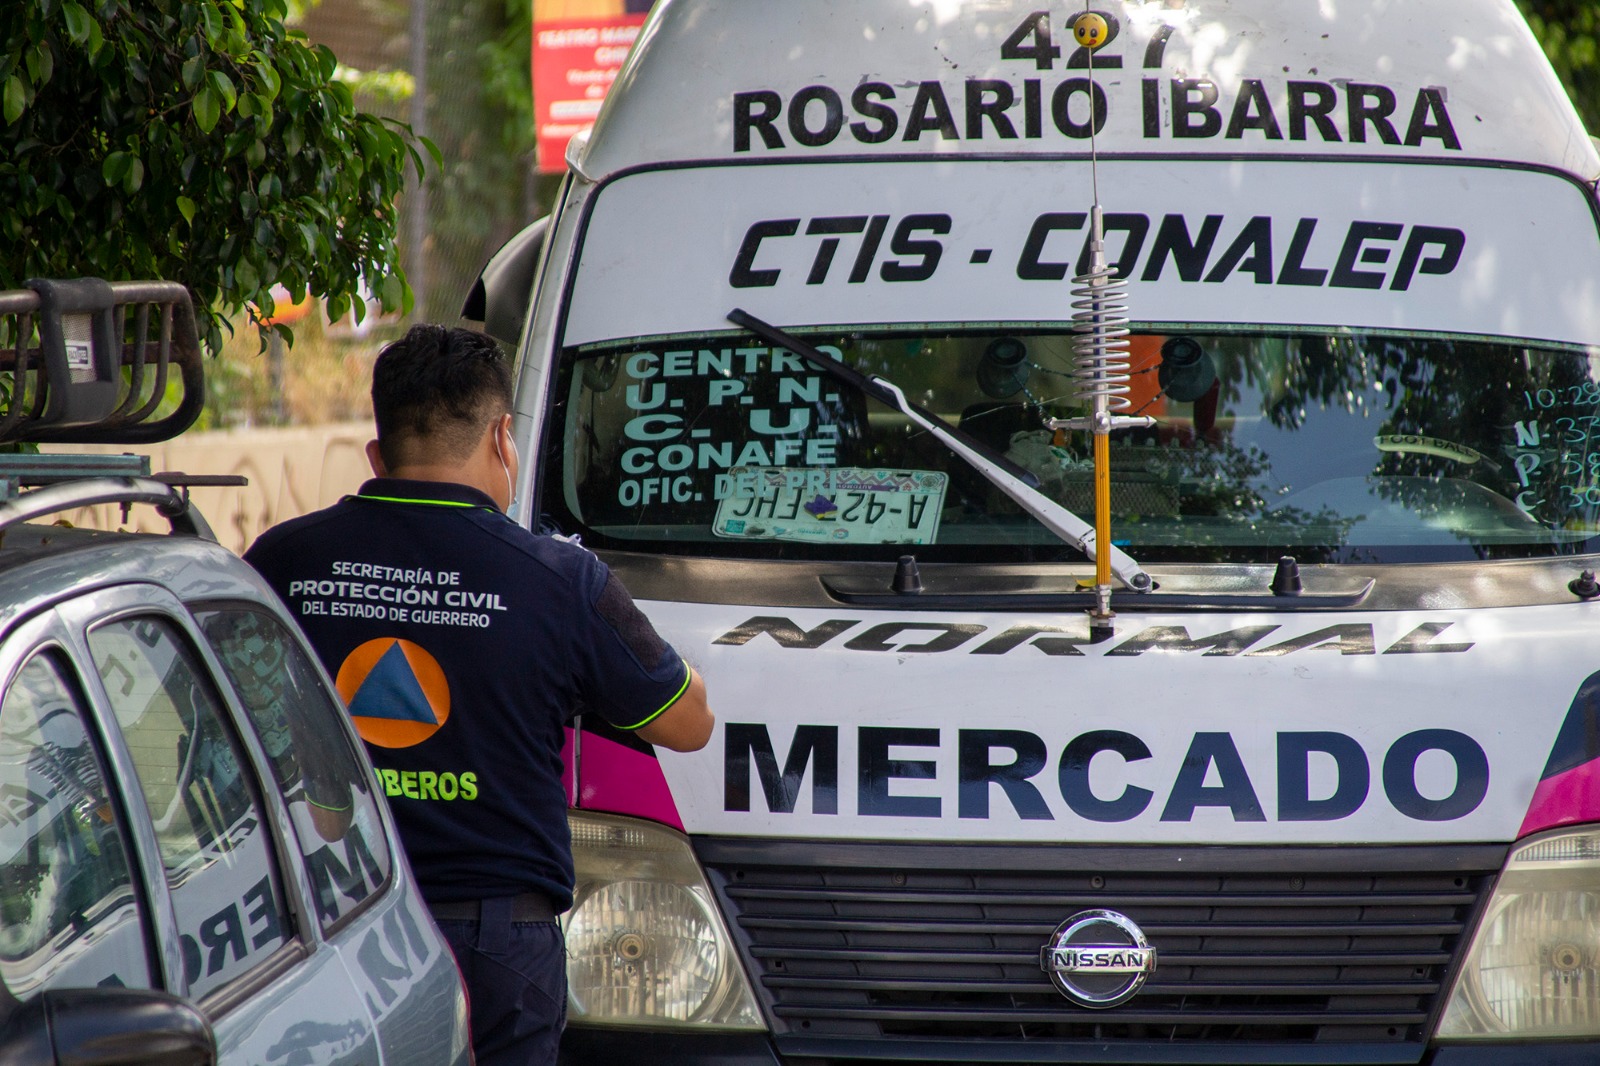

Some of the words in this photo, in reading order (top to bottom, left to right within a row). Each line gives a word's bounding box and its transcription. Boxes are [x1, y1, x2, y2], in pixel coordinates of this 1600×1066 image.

[600, 25, 645, 44] MAR
[731, 77, 1107, 152] ROSARIO
[1141, 78, 1462, 151] IBARRA
[729, 213, 952, 288] CTIS
[969, 248, 993, 264] -
[1016, 212, 1466, 291] CONALEP
[625, 345, 843, 379] CENTRO
[620, 438, 837, 475] CONAFE
[618, 475, 702, 507] OFIC.
[786, 469, 838, 498] PRI
[331, 561, 433, 585] SECRETARÍA
[437, 571, 460, 585] DE
[289, 580, 438, 606] PROTECCIÓN
[444, 591, 507, 611] CIVIL
[302, 601, 328, 615] DEL
[330, 602, 386, 620] ESTADO
[389, 609, 408, 622] DE
[411, 609, 490, 628] GUERRERO
[711, 616, 1476, 657] NORMAL
[373, 767, 478, 801] BEROS
[724, 722, 1490, 823] MERCADO
[1054, 952, 1143, 967] NISSAN
